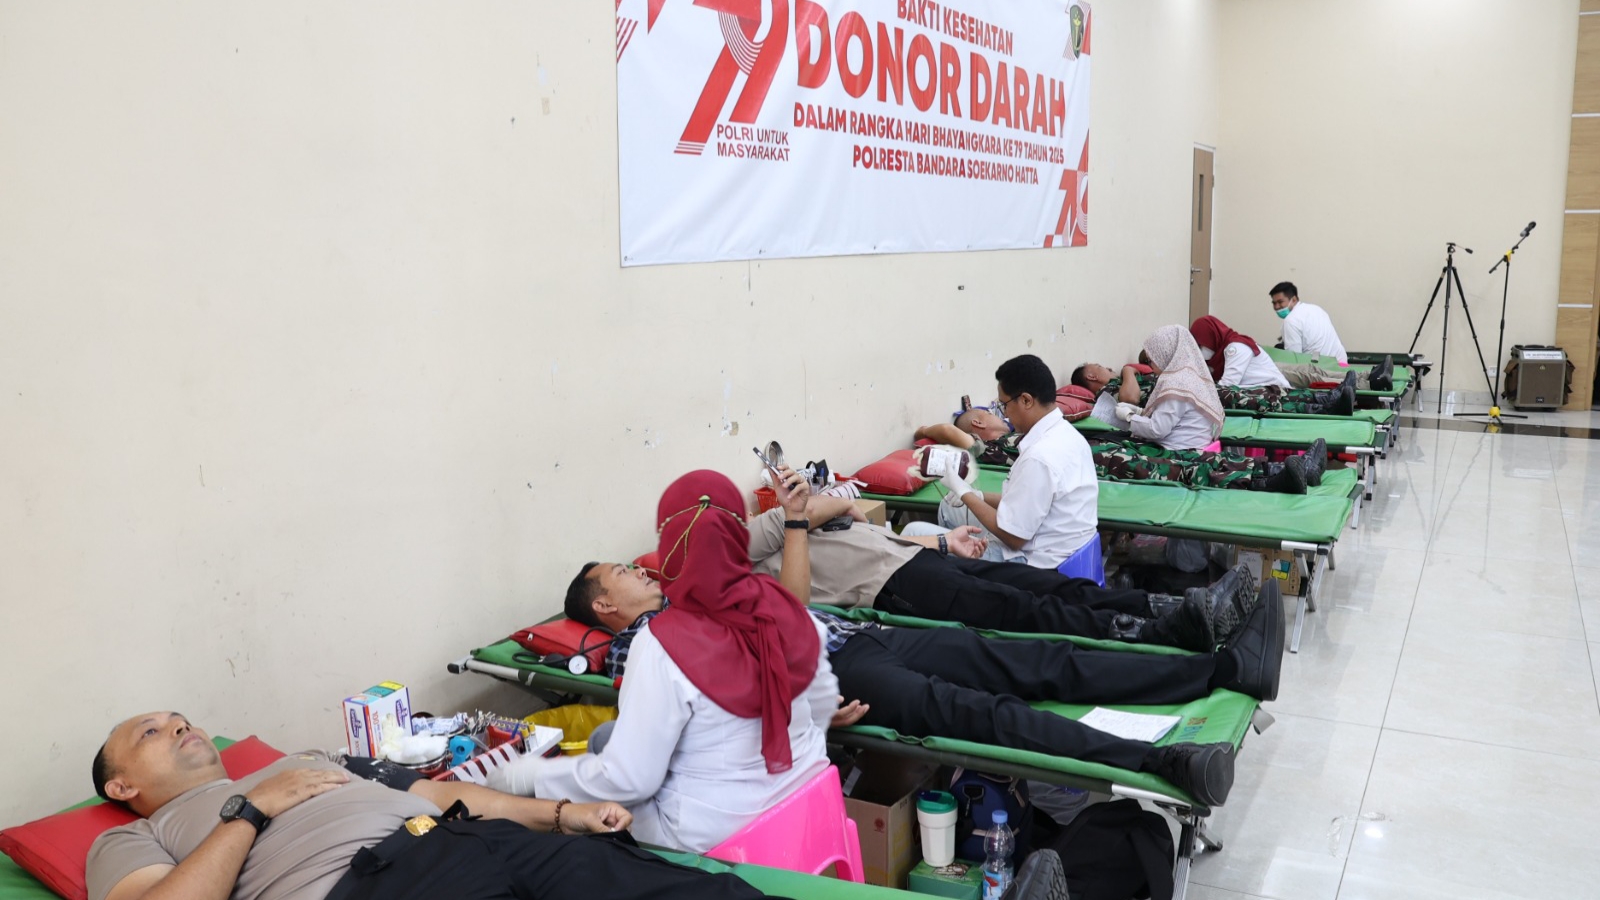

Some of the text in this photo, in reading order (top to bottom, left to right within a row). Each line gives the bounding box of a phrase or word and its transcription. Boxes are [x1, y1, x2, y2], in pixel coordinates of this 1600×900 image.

[898, 0, 1013, 57] BAKTI KESEHATAN
[795, 0, 1065, 138] DONOR DARAH
[716, 123, 789, 145] POLRI UNTUK
[717, 142, 790, 162] MASYARAKAT
[793, 101, 847, 133] DALAM
[849, 110, 904, 141] RANGKA
[905, 120, 931, 145] HARI
[932, 125, 1002, 155] BHAYANGKARA
[1003, 137, 1013, 157] KE
[1013, 139, 1023, 159] 79
[1024, 141, 1048, 162] TAHUN
[853, 144, 1039, 185] POLRESTA BANDARA SOEKARNO HATTA
